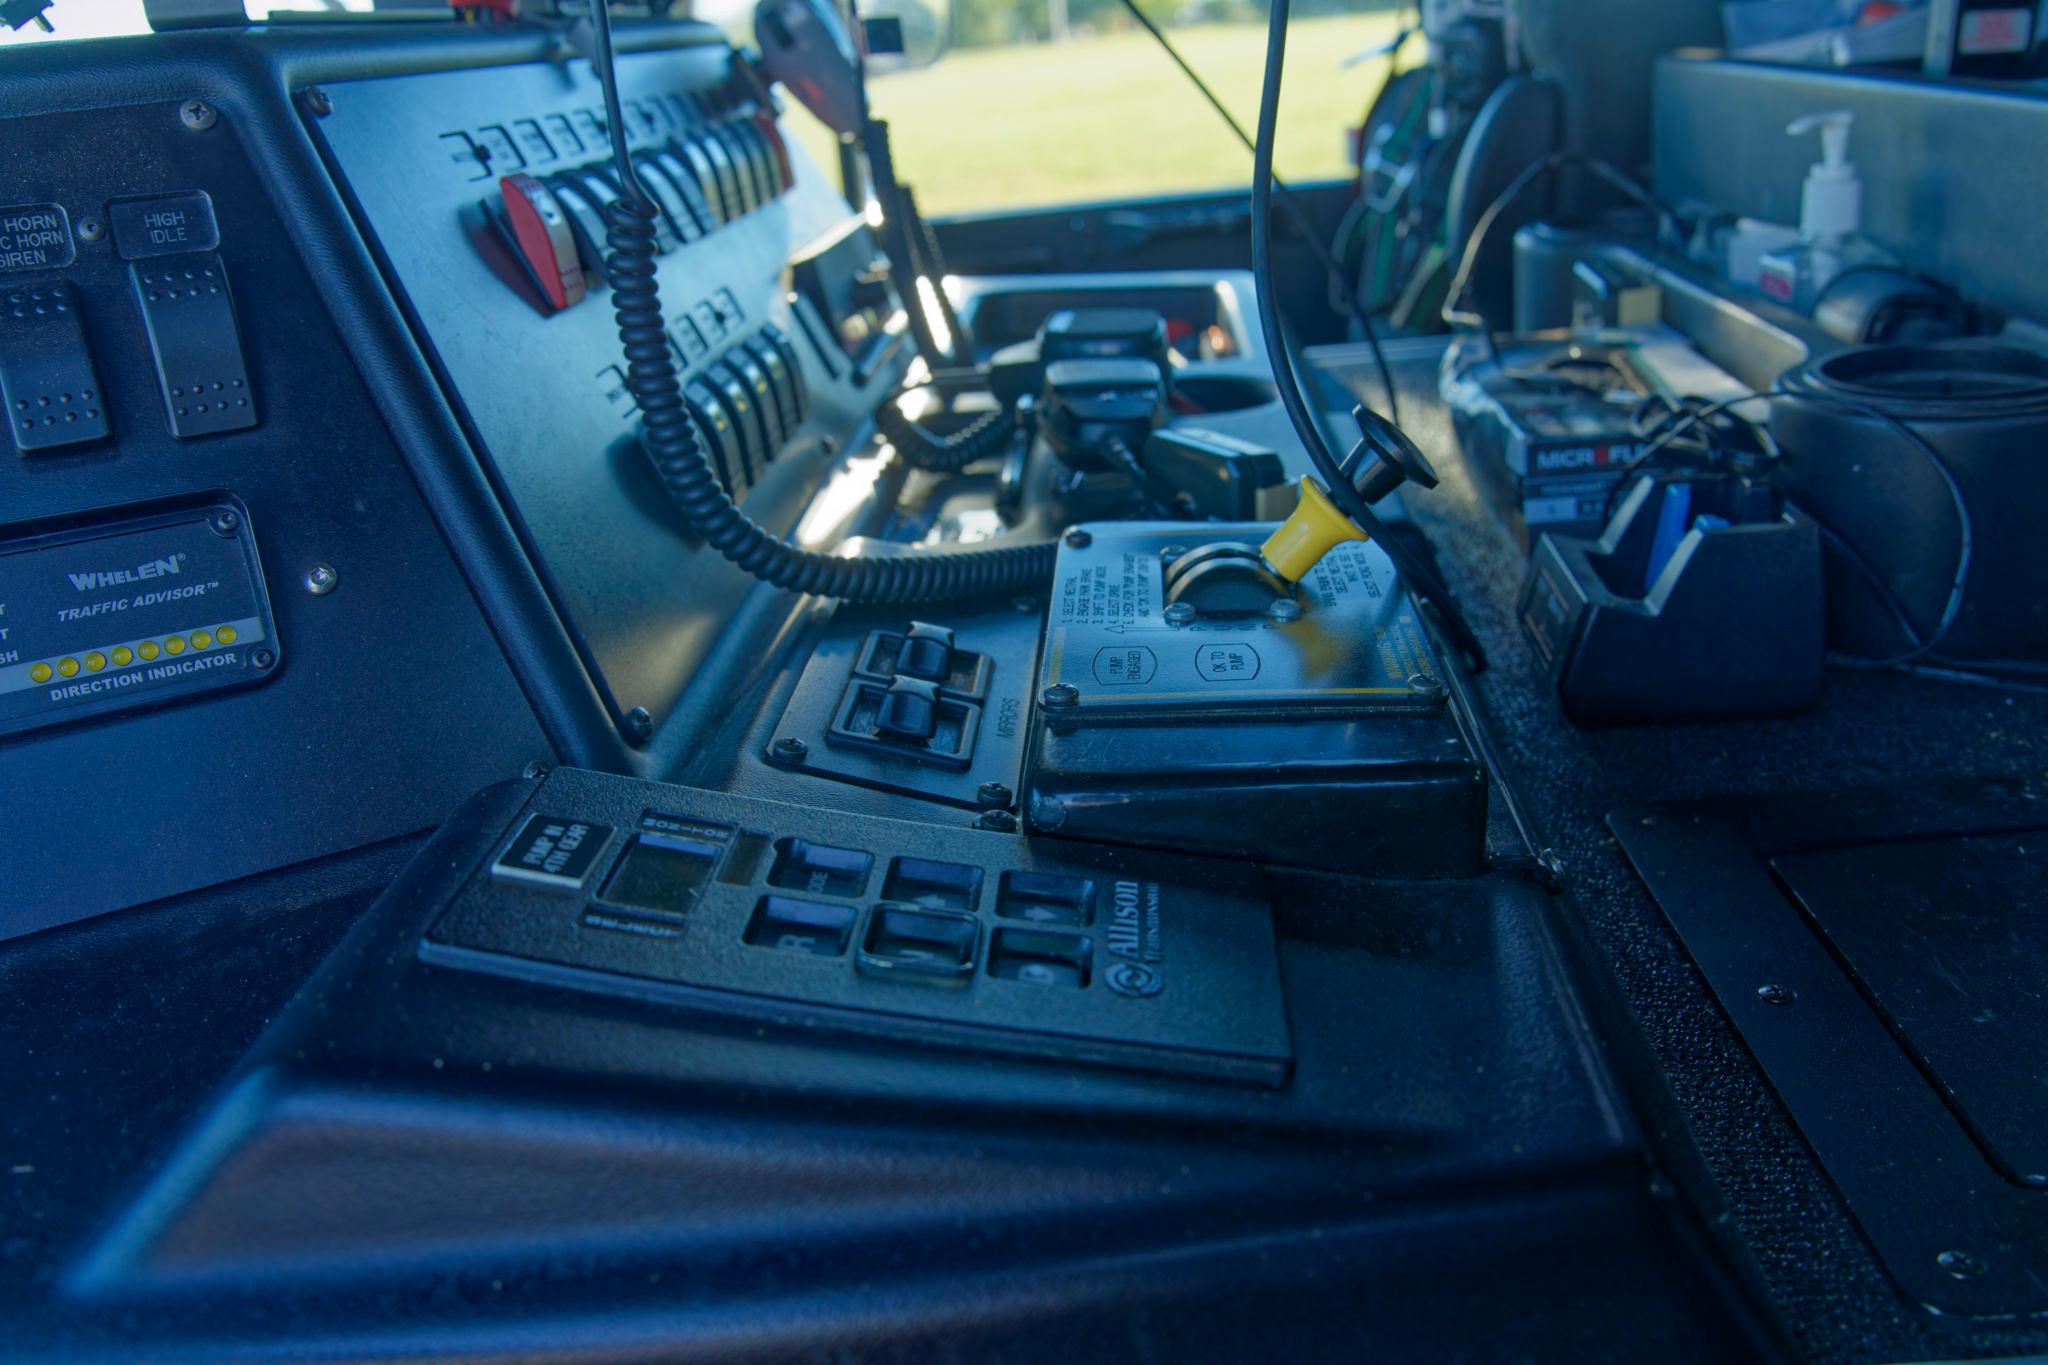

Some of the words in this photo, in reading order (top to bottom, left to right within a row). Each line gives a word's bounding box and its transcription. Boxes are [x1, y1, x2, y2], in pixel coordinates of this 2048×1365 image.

[4, 214, 58, 232] HORN
[143, 211, 186, 229] HIGH
[16, 230, 64, 248] HORN
[151, 227, 188, 244] IDLE
[58, 598, 129, 622] TRAFFIC
[1109, 657, 1123, 675] PUMP
[1127, 650, 1142, 681] ENGAGED
[1210, 651, 1226, 661] TO
[1212, 663, 1227, 673] OK
[1229, 653, 1245, 671] PUMP
[50, 667, 144, 702] DIRECTION
[147, 652, 238, 681] INDICATOR
[557, 823, 591, 851] GEAR
[641, 816, 731, 840] MONITOR
[522, 835, 555, 866] PUMP
[805, 871, 830, 895] ODE
[1106, 880, 1140, 961] Allison
[1143, 881, 1161, 961] Transmission
